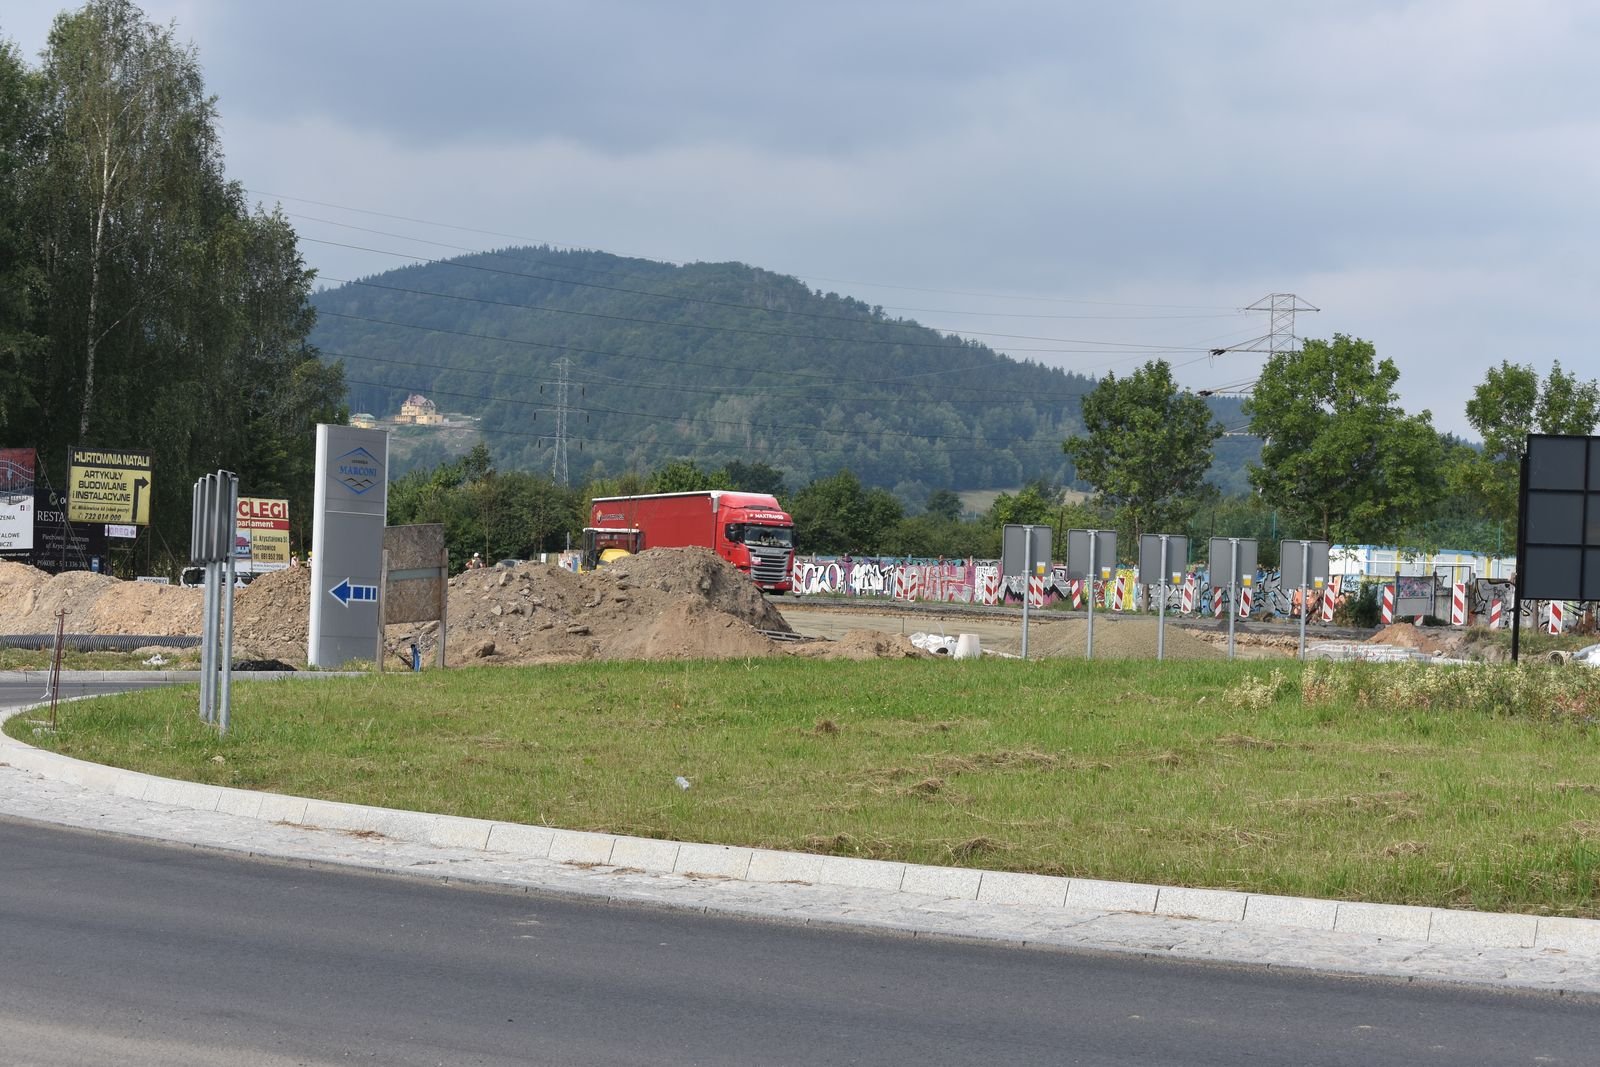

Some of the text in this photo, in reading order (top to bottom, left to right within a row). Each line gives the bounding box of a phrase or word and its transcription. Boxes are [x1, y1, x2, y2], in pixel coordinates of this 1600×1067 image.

[74, 451, 123, 465] HURTOWNIA
[84, 470, 124, 480] ARTYKUŁY
[79, 481, 127, 491] BUDOWLANE
[76, 491, 131, 502] INSTALACYJNE
[236, 501, 287, 518] CLEGI
[37, 510, 66, 522] RESTA
